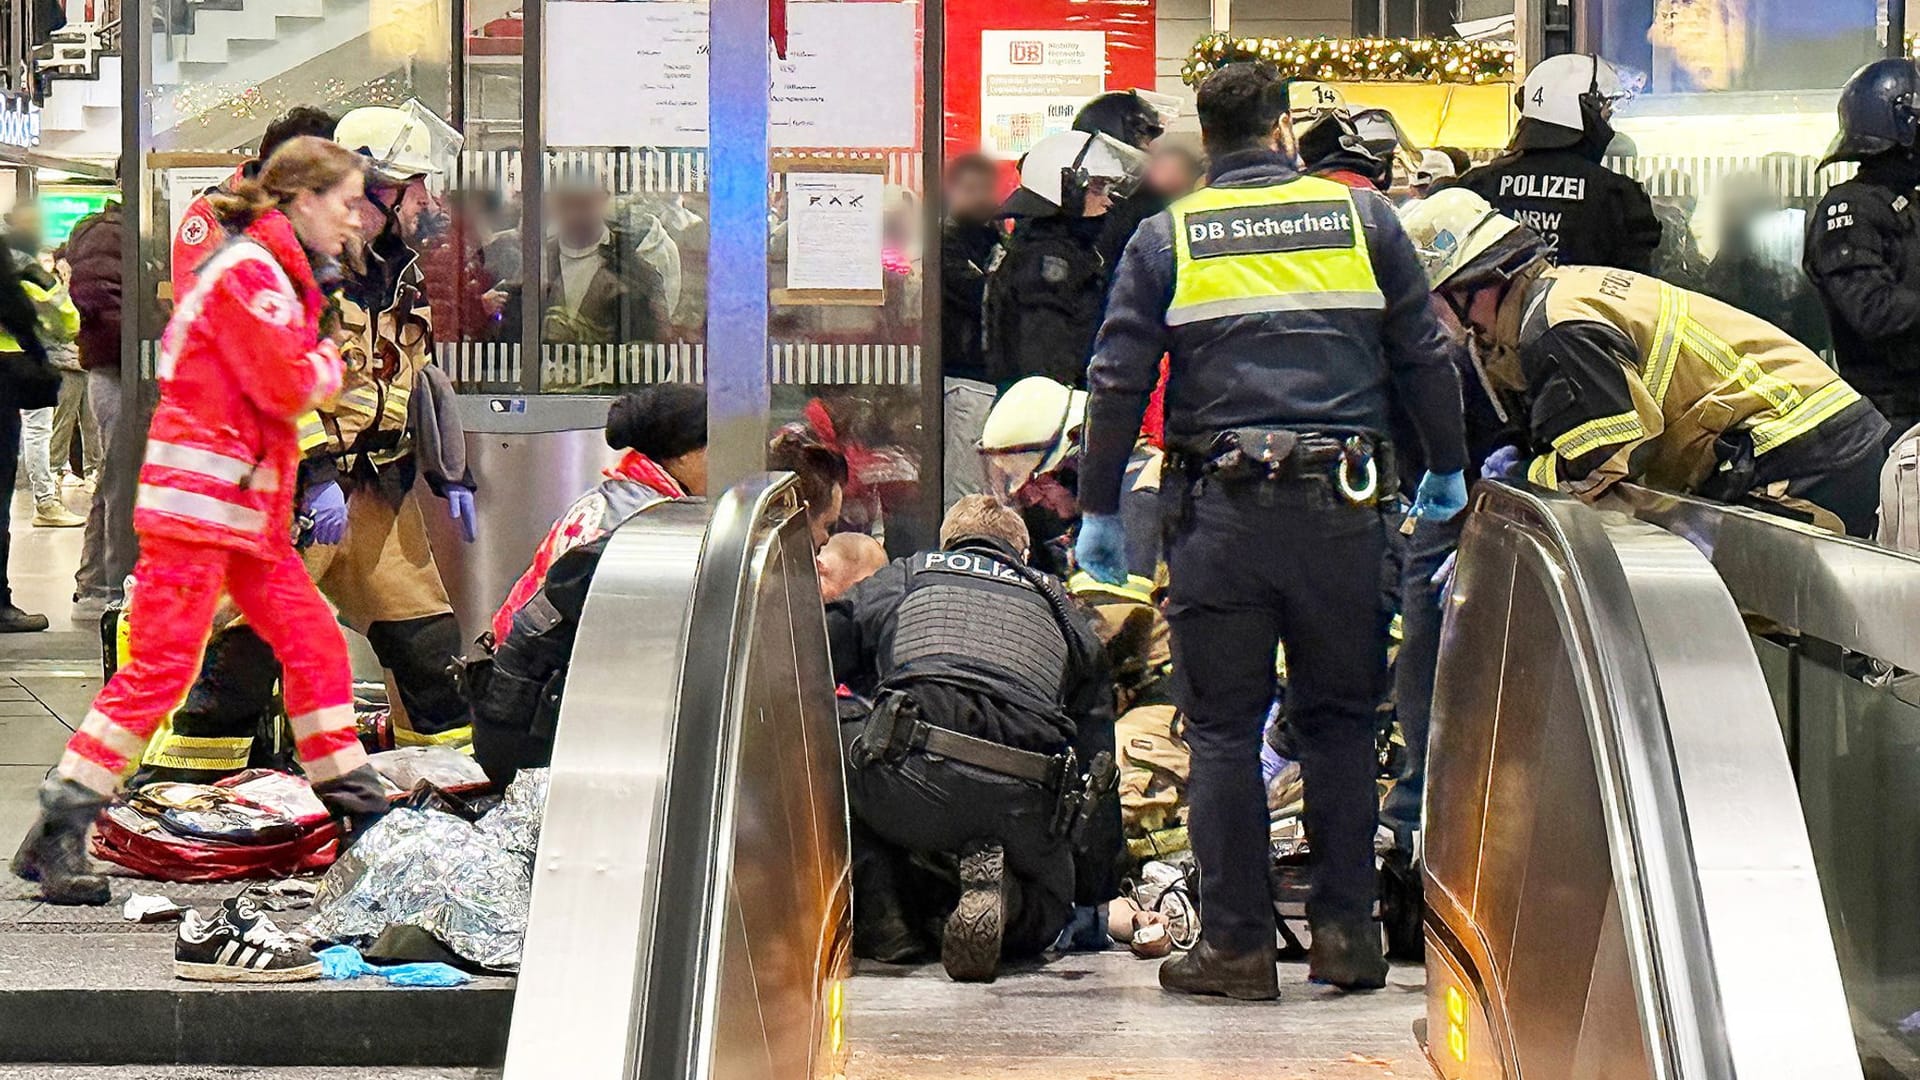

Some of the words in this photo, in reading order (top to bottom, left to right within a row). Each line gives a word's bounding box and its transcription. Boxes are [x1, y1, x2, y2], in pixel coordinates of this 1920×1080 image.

[1012, 42, 1042, 63] DB
[1312, 85, 1336, 104] 14
[1531, 86, 1544, 107] 4
[1499, 174, 1585, 200] POLIZEI
[1189, 222, 1225, 243] DB
[1231, 211, 1351, 238] Sicherheit
[1513, 208, 1562, 231] NRW
